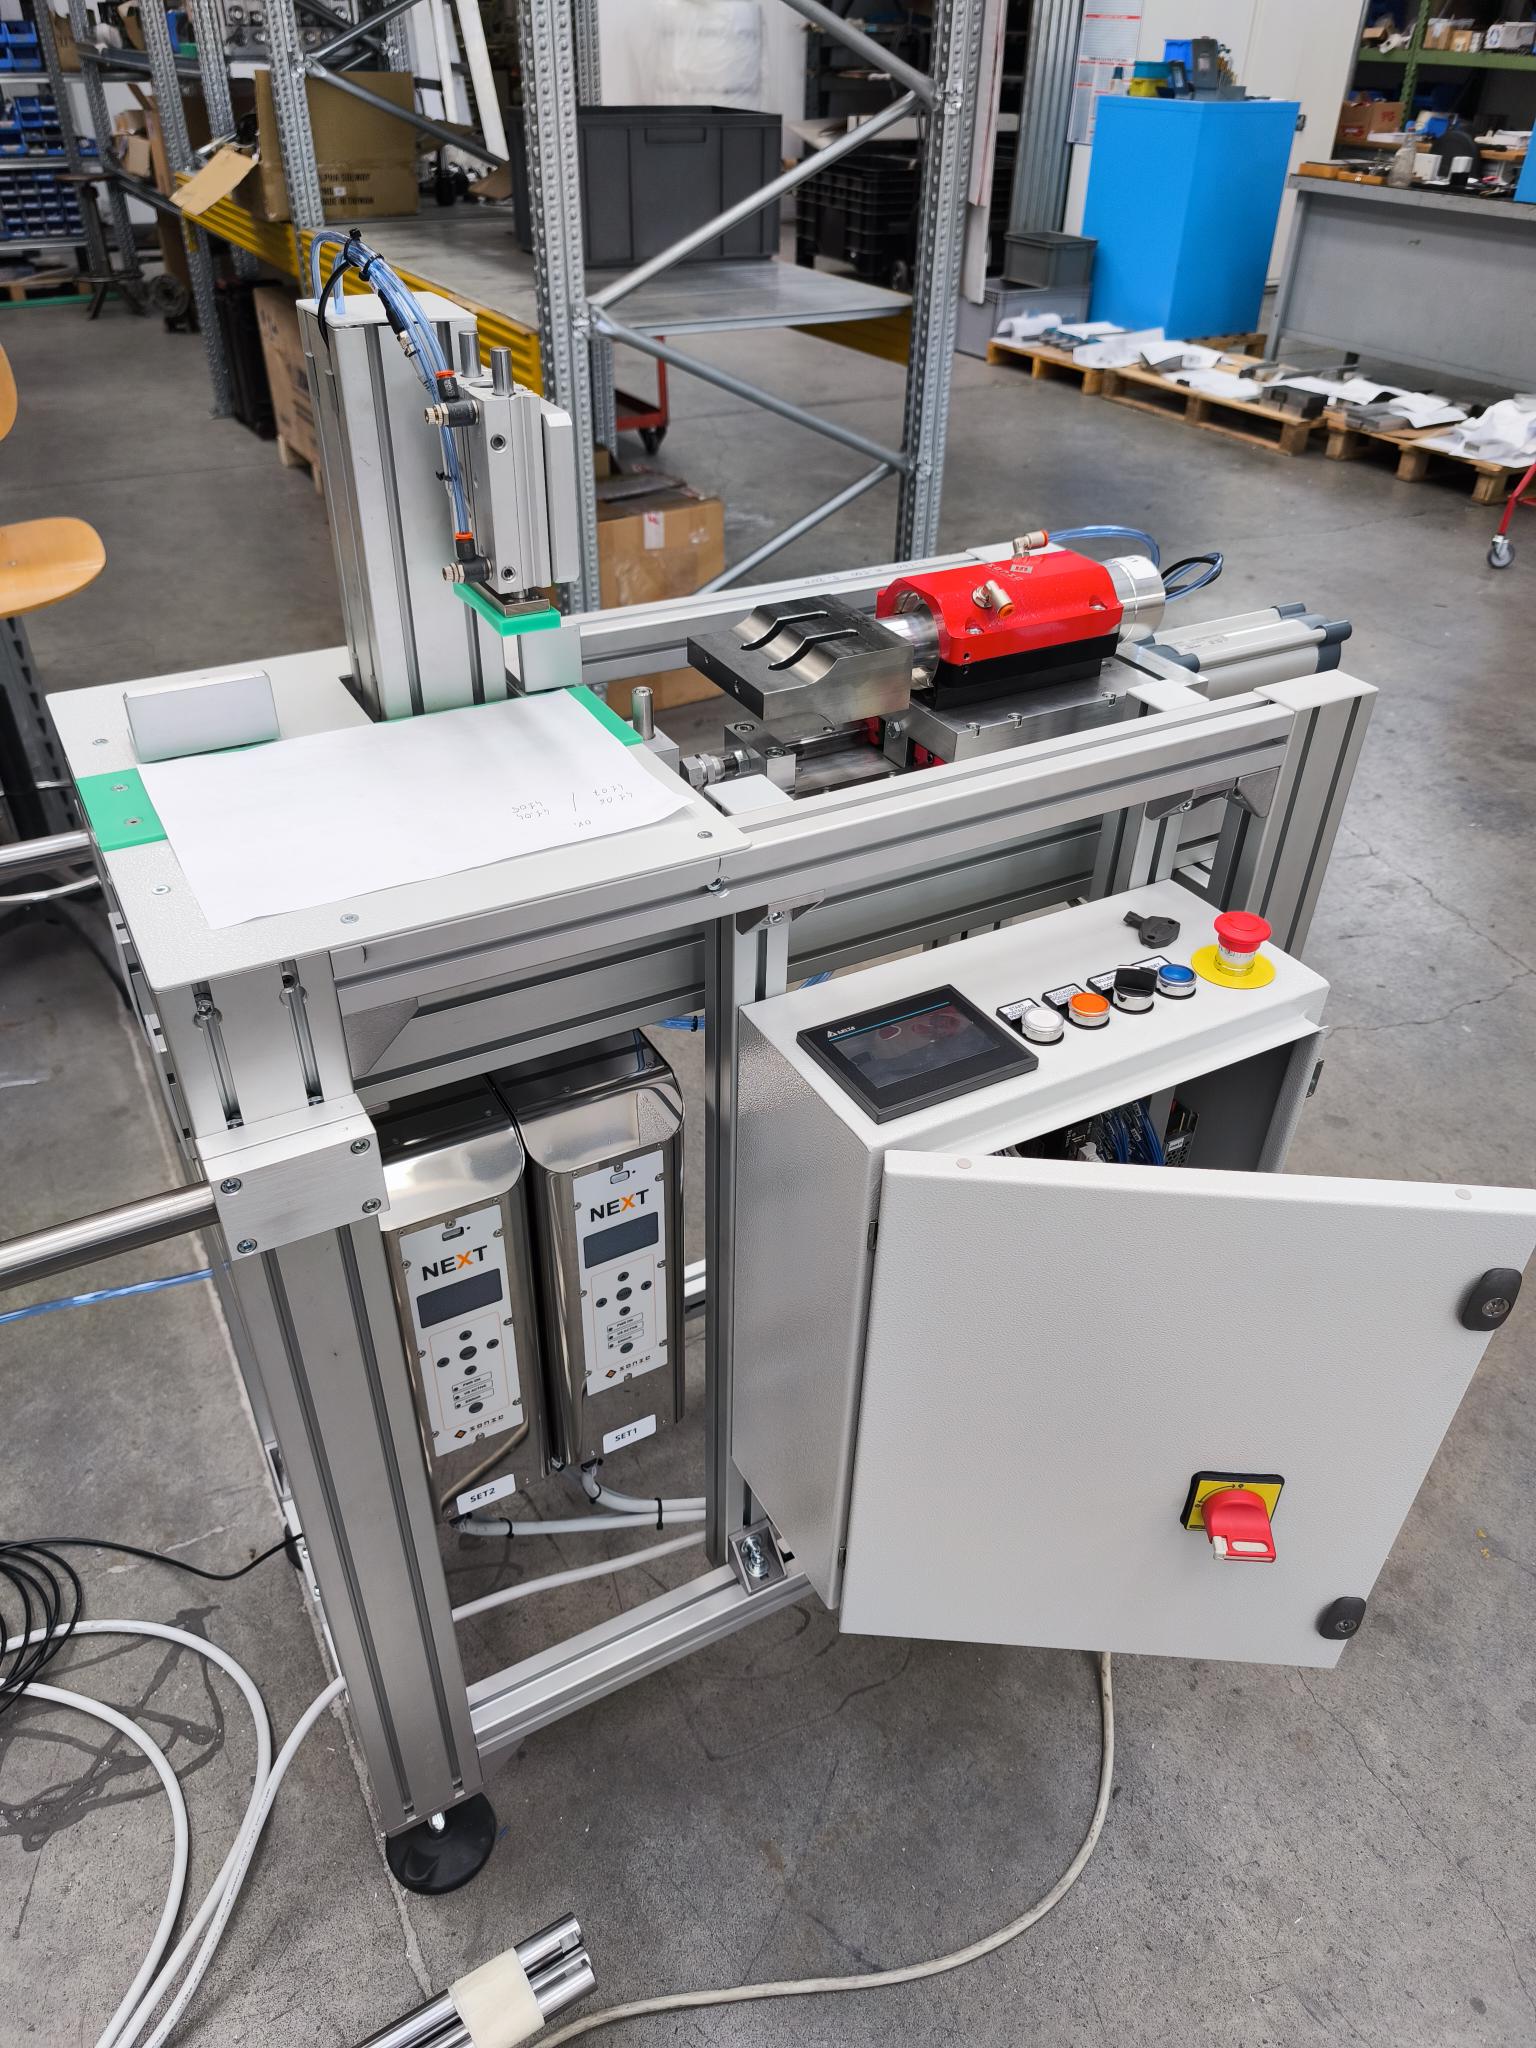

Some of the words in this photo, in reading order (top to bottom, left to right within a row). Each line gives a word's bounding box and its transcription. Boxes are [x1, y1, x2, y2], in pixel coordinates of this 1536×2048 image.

[590, 1188, 650, 1222] NEXT
[421, 1244, 488, 1281] NEXT
[615, 1427, 637, 1442] SET1
[470, 1487, 496, 1503] SET2
